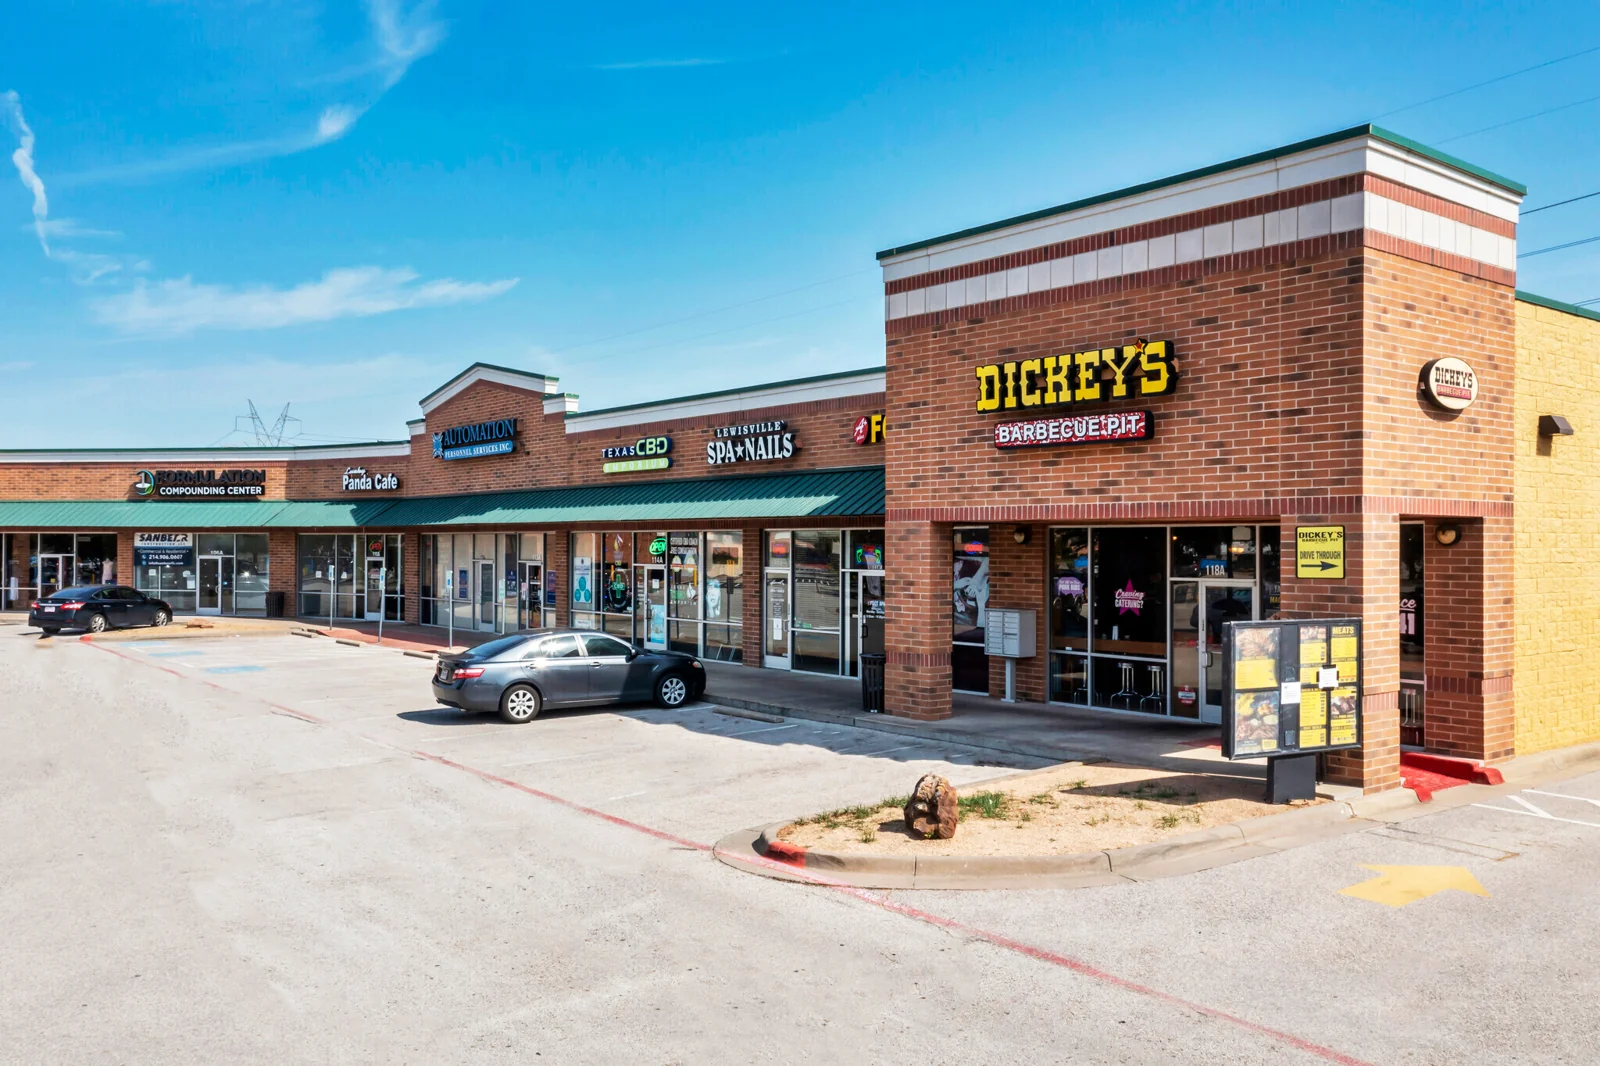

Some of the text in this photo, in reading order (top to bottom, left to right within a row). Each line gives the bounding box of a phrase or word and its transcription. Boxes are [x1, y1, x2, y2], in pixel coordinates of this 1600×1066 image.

[976, 340, 1170, 411] DICKEY'S
[1435, 367, 1473, 388] DICKEY'S
[444, 418, 514, 446] AUTOMATION
[717, 421, 781, 438] LEWISVILLE
[871, 414, 887, 443] F
[999, 415, 1140, 443] BARBECUE PIT
[445, 448, 472, 459] PERSONNEL
[473, 444, 499, 457] SERVICES
[602, 437, 668, 458] TEXAS CBD
[707, 433, 793, 465] SPA NAILS
[604, 459, 666, 473] EMPORIUM
[155, 469, 266, 483] FORMULATION
[343, 473, 398, 490] Panda Cafe
[160, 486, 262, 495] COMPOUNDING CENTER
[1298, 531, 1343, 539] DICKEY'S
[650, 541, 667, 552] OPEN
[651, 556, 664, 564] 114A
[1300, 551, 1342, 560] DRIVE THROUGH
[1205, 564, 1226, 576] 118A
[1115, 588, 1145, 600] Craving
[1114, 599, 1144, 609] CATERING?
